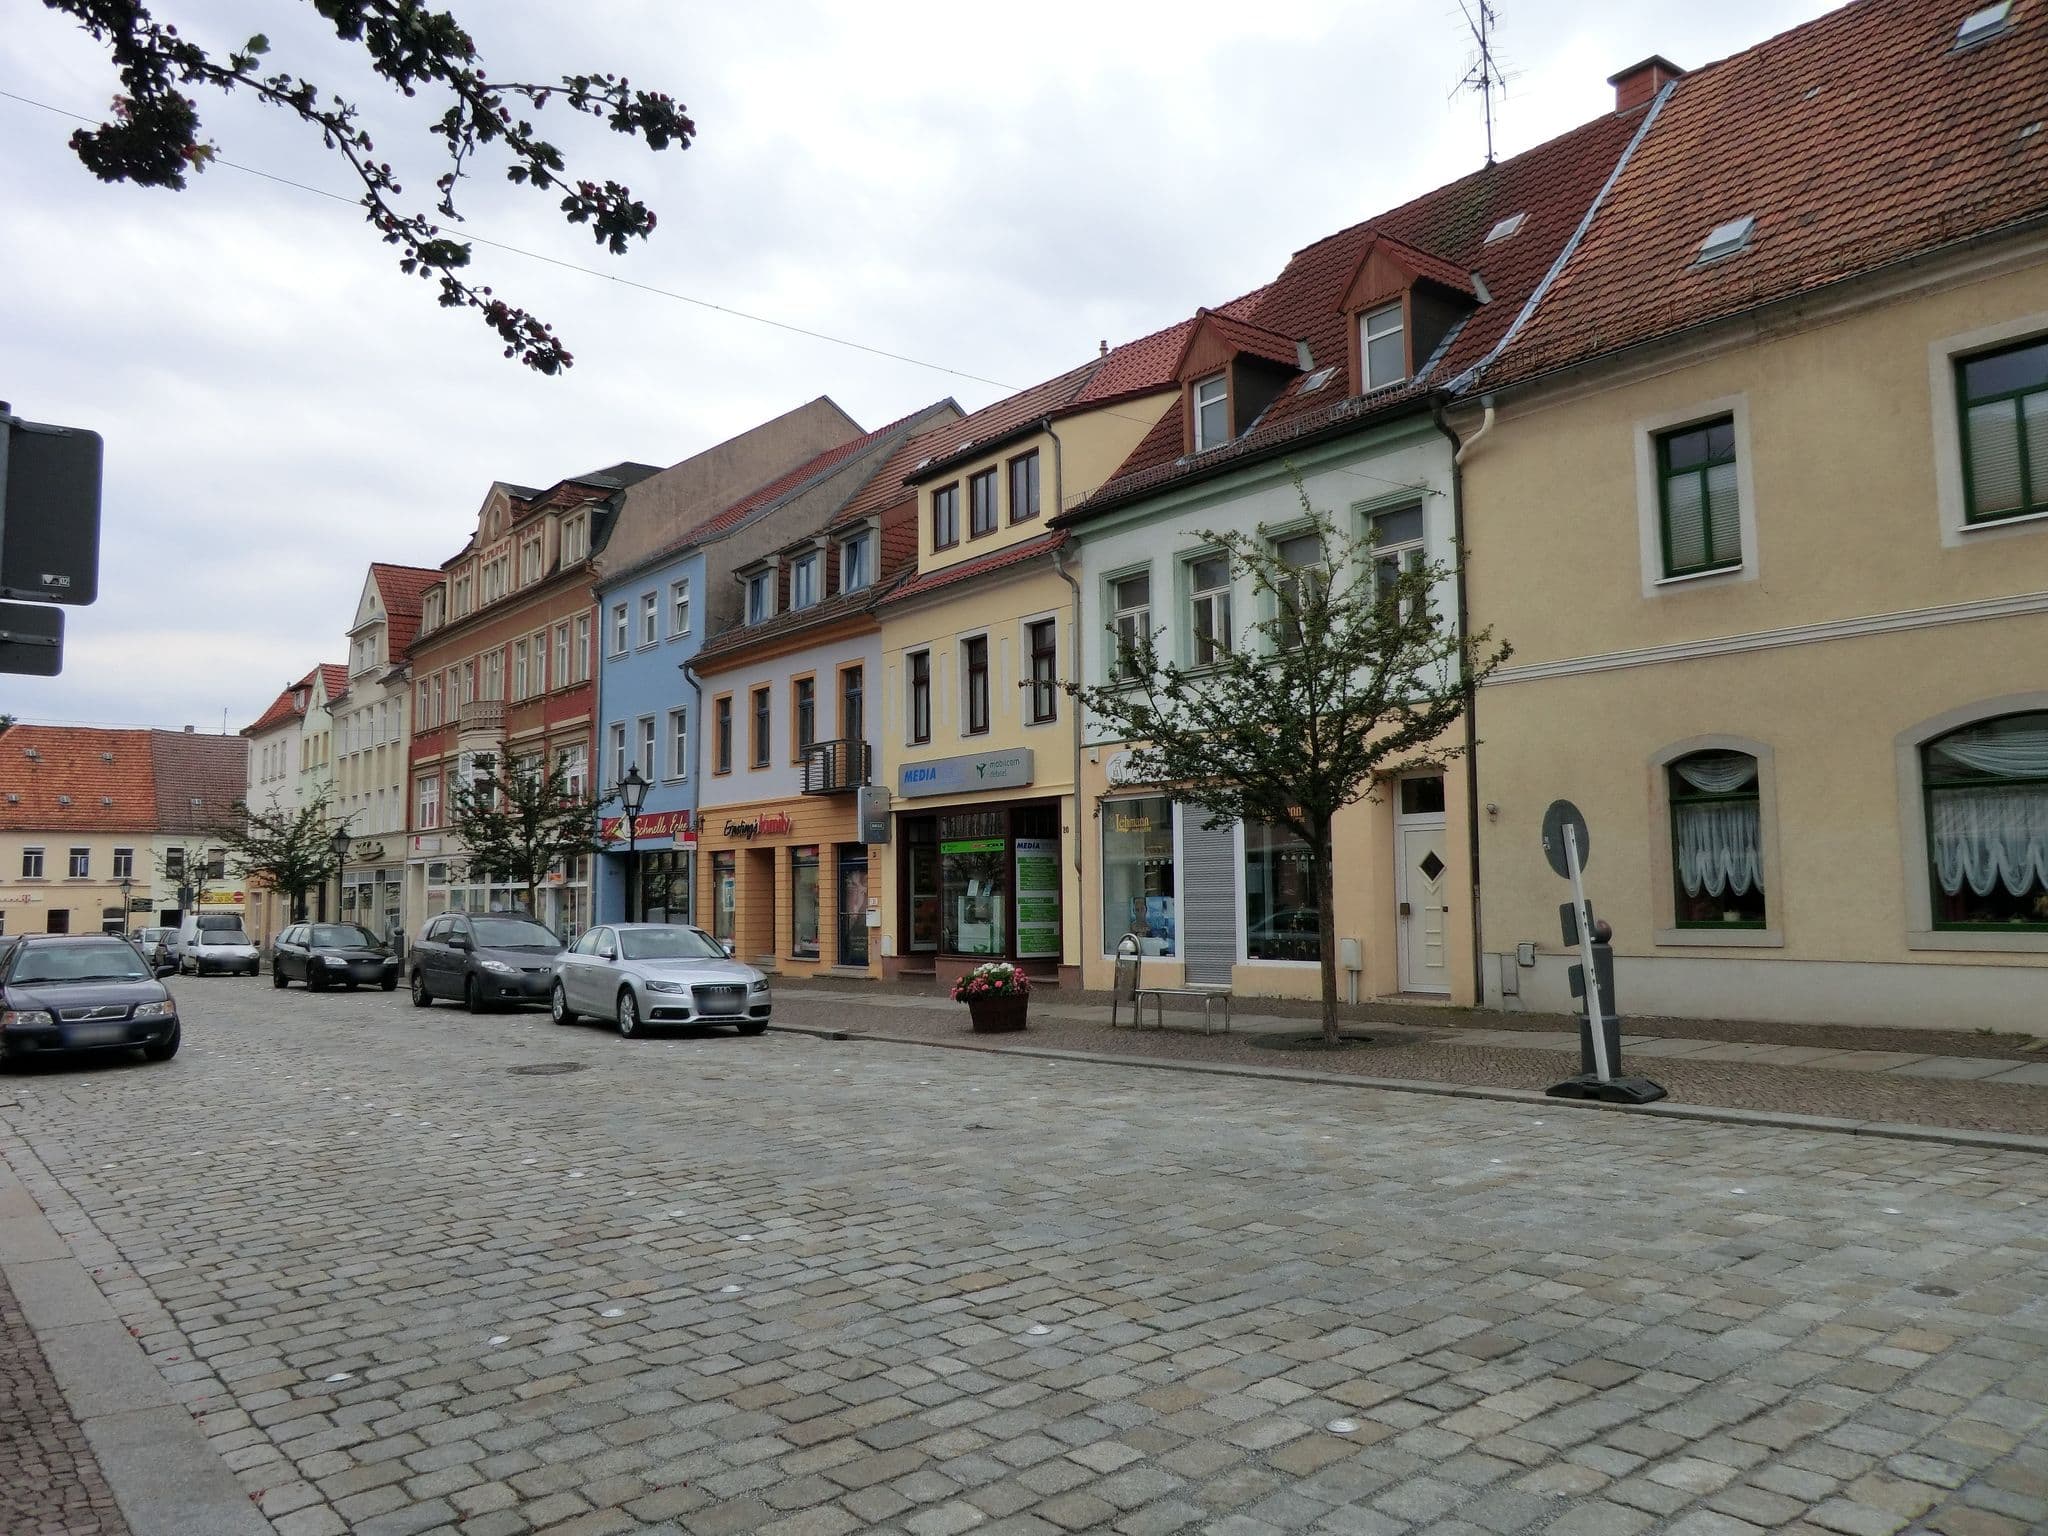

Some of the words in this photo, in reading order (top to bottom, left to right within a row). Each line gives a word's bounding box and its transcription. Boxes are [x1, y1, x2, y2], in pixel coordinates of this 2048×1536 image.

[904, 767, 937, 782] MEDIA
[634, 817, 667, 837] Schnelle
[669, 813, 689, 833] Ecke
[1016, 842, 1041, 850] MEDIA
